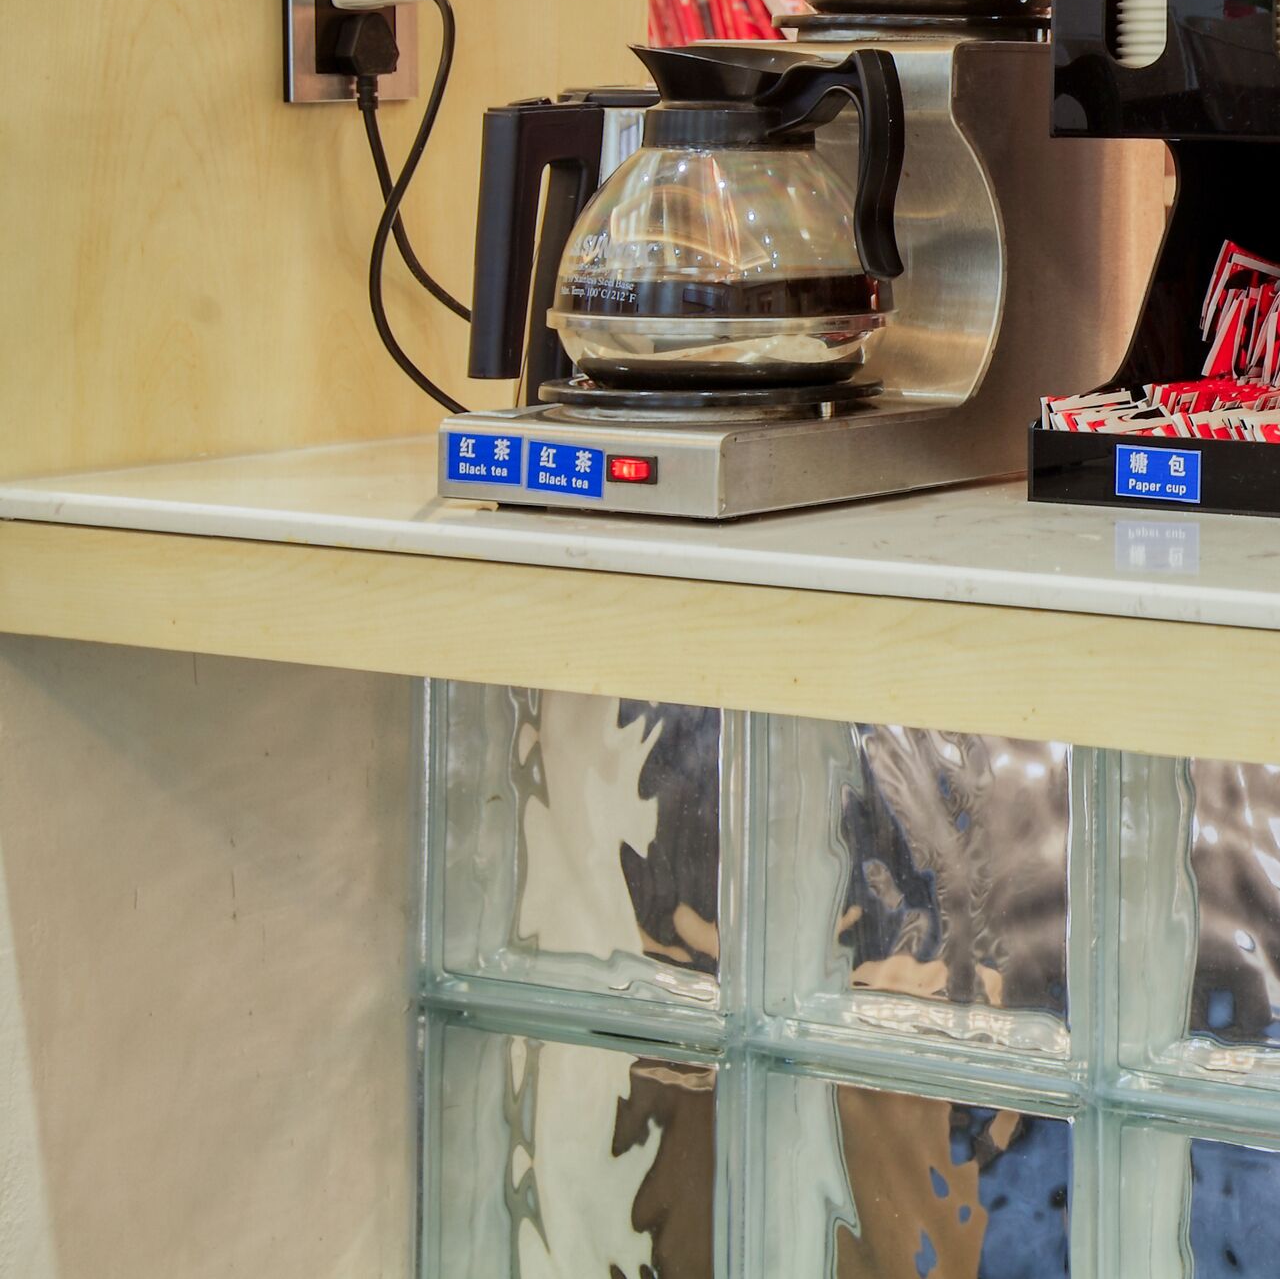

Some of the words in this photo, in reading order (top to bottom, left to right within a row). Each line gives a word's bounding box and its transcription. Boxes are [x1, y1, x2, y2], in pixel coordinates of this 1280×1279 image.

[459, 437, 511, 461] 红茶
[540, 446, 592, 473] 红茶
[459, 462, 487, 476] Black
[491, 465, 508, 477] tea
[1130, 452, 1185, 476] 糖包
[539, 471, 567, 486] Black
[572, 476, 589, 489] tea
[1128, 478, 1161, 492] Paper
[1166, 484, 1186, 496] cup
